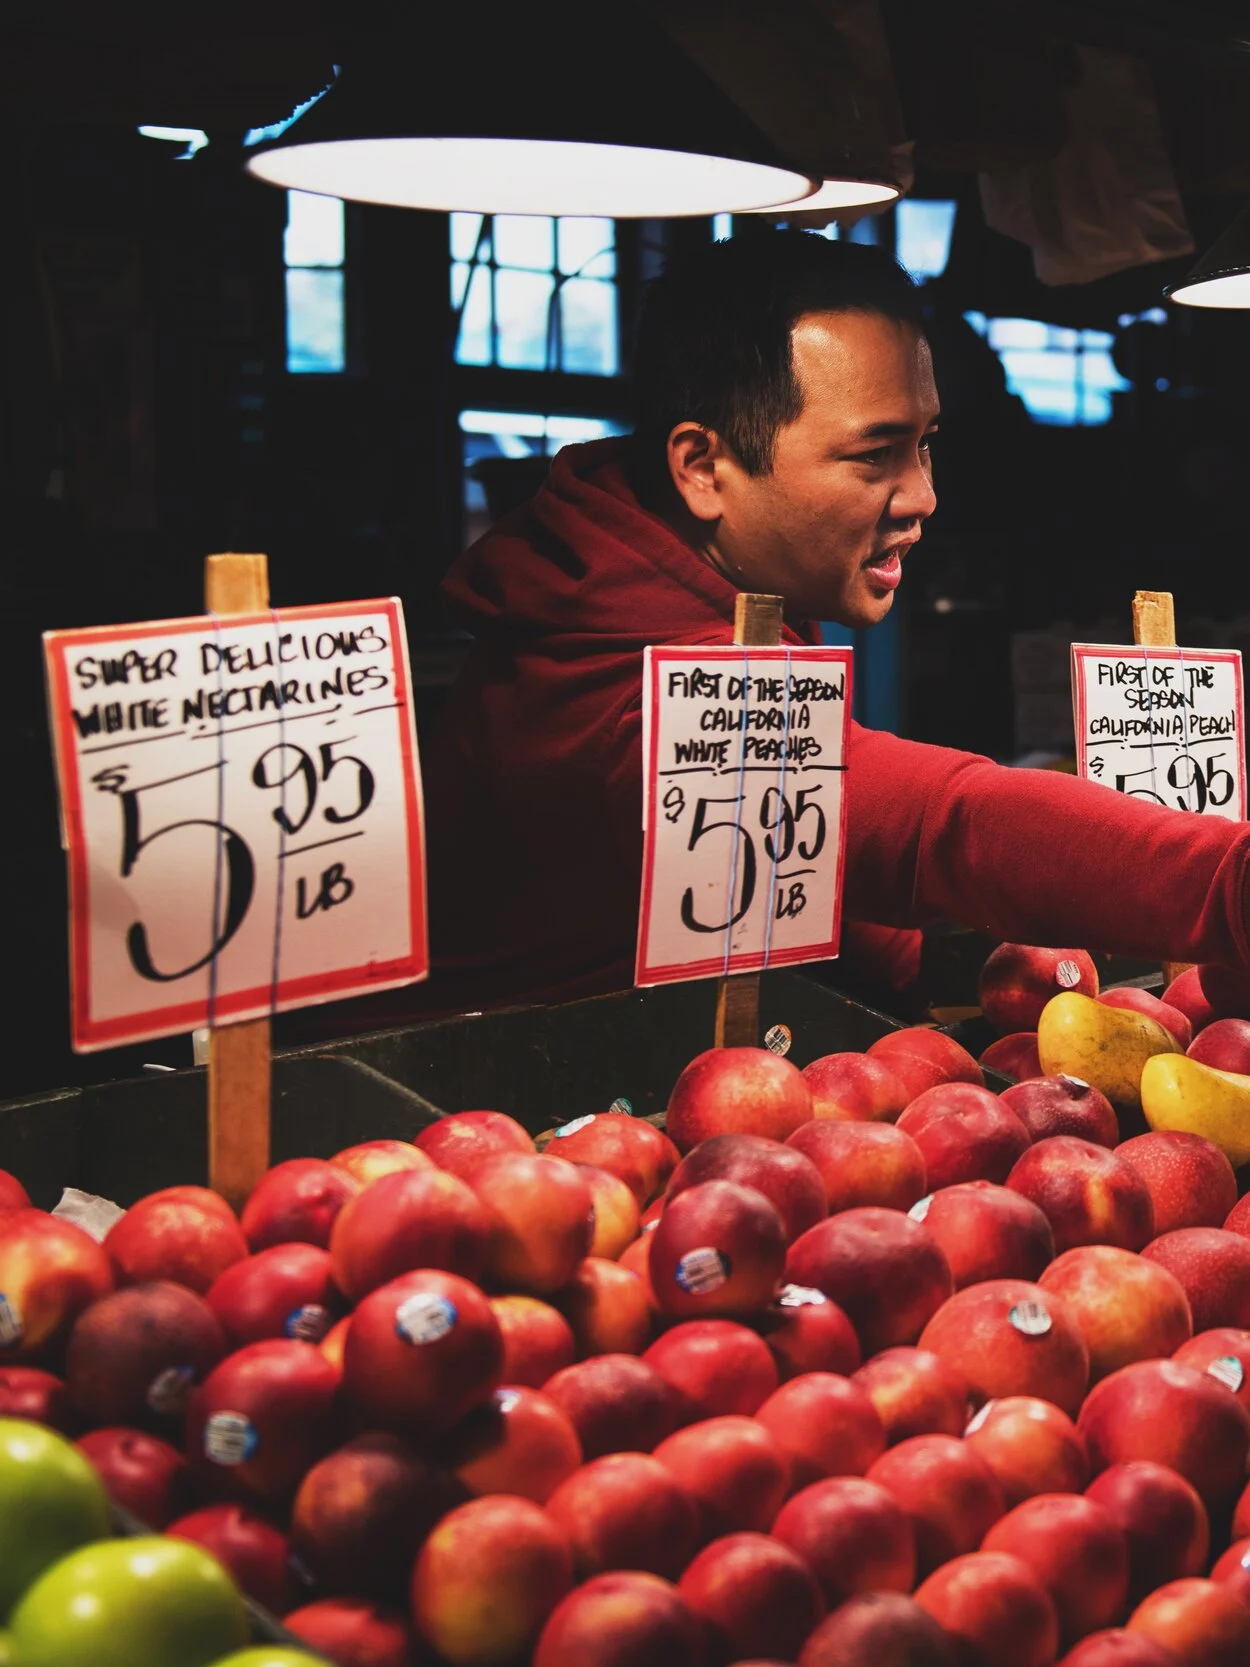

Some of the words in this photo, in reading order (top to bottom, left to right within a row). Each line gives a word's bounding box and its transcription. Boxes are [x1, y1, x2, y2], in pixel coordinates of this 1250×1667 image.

[75, 648, 176, 689] SUPER
[201, 625, 387, 675] DELICIOUS
[1098, 661, 1146, 687] FIRST
[1153, 665, 1174, 687] OF
[1185, 666, 1215, 688] THE
[72, 699, 168, 738] WHITE
[182, 665, 390, 722] NECTARINES
[668, 667, 723, 699] FIRST
[727, 673, 752, 700] OF
[753, 676, 784, 702] THE
[787, 673, 844, 702] SEASON
[1125, 686, 1195, 711] SEASON
[700, 704, 810, 731] CALIFORNIA
[1090, 715, 1183, 737] CALIFORNIA
[1190, 710, 1235, 737] PEACH
[674, 739, 732, 765] WHITE
[743, 737, 823, 765] PEACHES
[252, 735, 374, 834] 95
[681, 795, 756, 932] 5
[760, 785, 825, 863] 95
[296, 863, 353, 920] LB
[776, 883, 807, 919] LB
